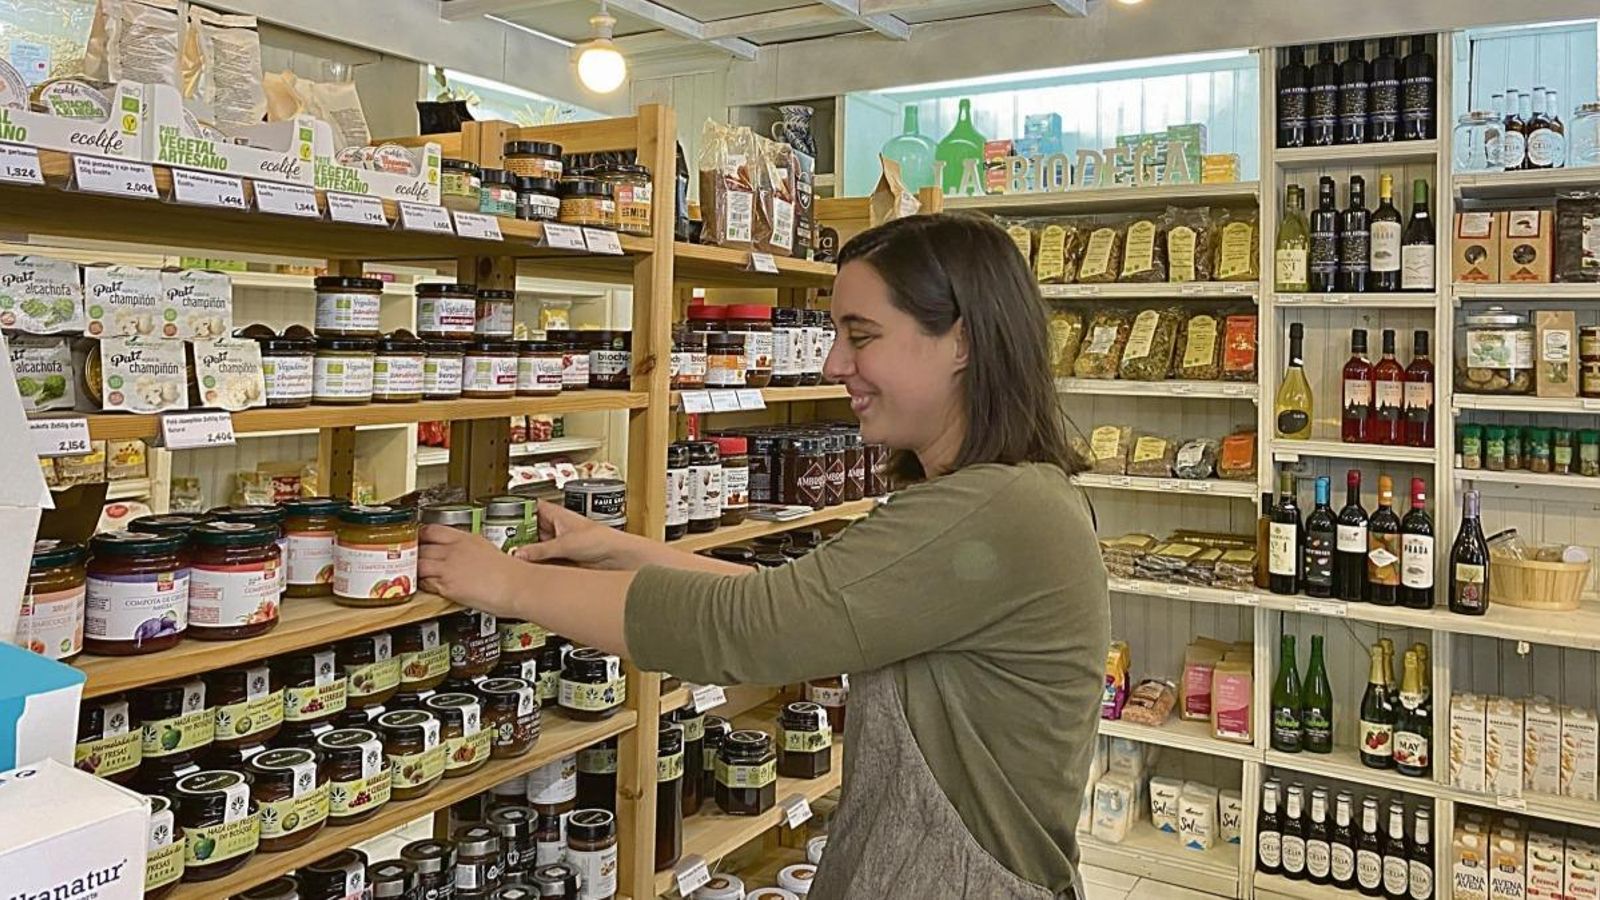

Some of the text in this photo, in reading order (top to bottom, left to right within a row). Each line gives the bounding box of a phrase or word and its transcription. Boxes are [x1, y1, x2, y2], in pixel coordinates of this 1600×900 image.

[71, 129, 123, 153] ecolife
[159, 135, 216, 155] VEGETAL
[158, 151, 228, 171] ARTESANO
[260, 157, 300, 179] ecolife
[1003, 142, 1194, 194] BIODEGA
[314, 163, 360, 180] VEGETAL
[314, 175, 369, 194] ARTESANO
[395, 181, 429, 199] ecolife
[25, 283, 72, 297] alcachofa
[109, 294, 157, 308] champiñón
[182, 296, 227, 310] champiñón
[16, 361, 63, 375] alcachofa
[129, 361, 179, 376] champiñón
[1404, 544, 1429, 555] PRADA
[125, 599, 161, 608] COMPOTA
[91, 739, 129, 752] Mermelada
[1400, 741, 1420, 751] MAY
[103, 748, 128, 760] FRESAS
[106, 756, 132, 767] EXTRA
[1153, 800, 1167, 814] Sal
[1180, 816, 1195, 832] Sal
[1223, 812, 1238, 828] Sal
[146, 847, 175, 863] melada
[1455, 872, 1485, 885] AVENA
[1492, 877, 1523, 891] AVENA
[1456, 881, 1484, 892] AVEIA
[1493, 887, 1521, 898] AVEIA
